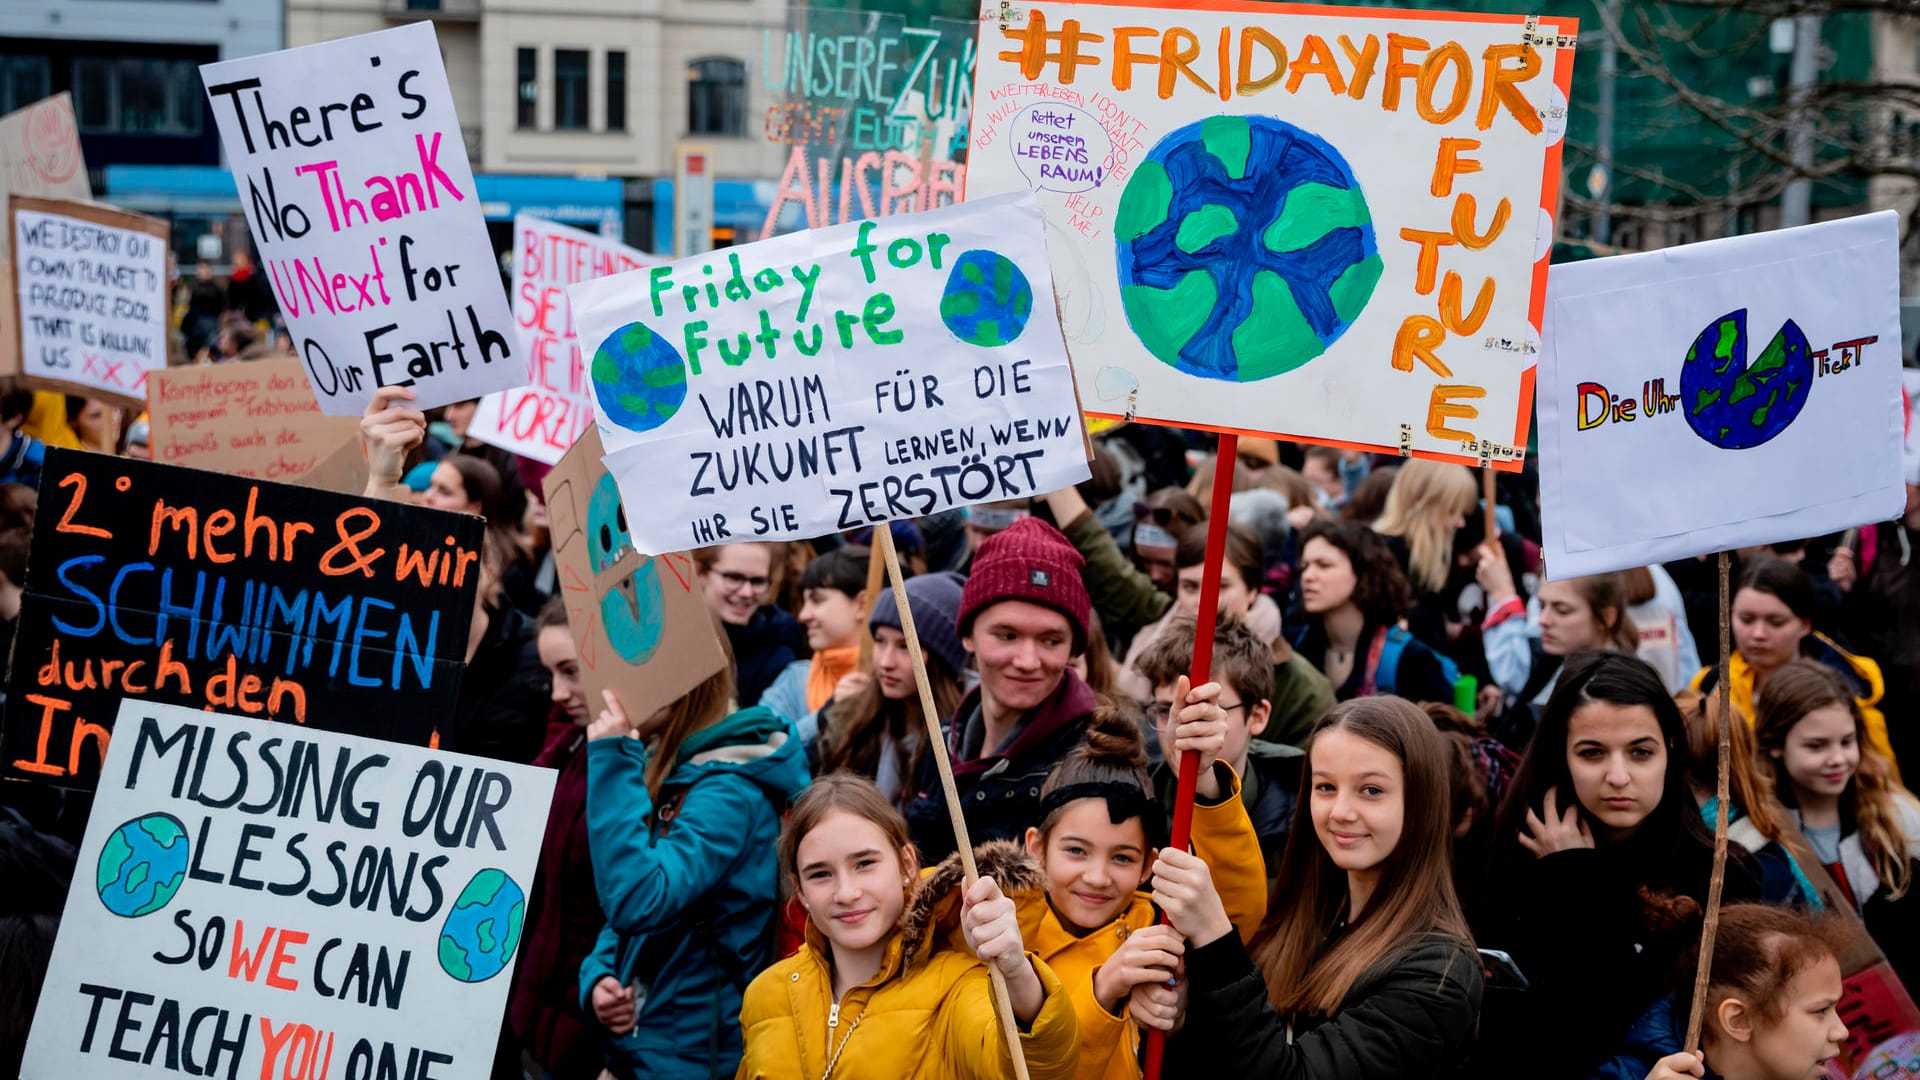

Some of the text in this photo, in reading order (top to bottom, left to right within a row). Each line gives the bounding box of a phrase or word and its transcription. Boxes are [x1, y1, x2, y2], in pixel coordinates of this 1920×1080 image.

[762, 29, 898, 103] UNSERE
[208, 56, 427, 154] There's
[765, 101, 846, 146] GEHT
[854, 108, 938, 153] EUCH
[976, 83, 1085, 150] ICH WILL WEITERLEBEN
[1028, 131, 1085, 148] unseren
[1032, 109, 1076, 130] Rettet
[1100, 116, 1144, 153] WANT
[1017, 142, 1088, 164] LEBENS
[1040, 163, 1103, 187] RAUM!
[20, 219, 57, 249] WE
[249, 167, 311, 244] No
[1064, 192, 1103, 219] HELP
[26, 256, 74, 280] OWN
[78, 259, 138, 291] PLANET
[399, 234, 460, 301] for
[523, 229, 589, 284] BITTE
[650, 252, 821, 323] Friday
[850, 221, 950, 284] for
[29, 315, 73, 339] THAT
[79, 323, 97, 346] IS
[40, 345, 71, 369] US
[304, 337, 364, 397] Our
[363, 304, 512, 388] Earth
[684, 292, 904, 375] Future
[699, 359, 1032, 439] WARUM FÜR DIE
[1577, 381, 1637, 431] Die
[1643, 378, 1680, 418] Uhr
[690, 425, 866, 497] ZUKUNFT
[990, 415, 1071, 446] WENN
[692, 512, 731, 545] IHR
[750, 504, 799, 535] SIE
[829, 449, 1045, 530] ZERSTÖRT
[148, 486, 315, 564] mehr
[318, 506, 385, 579] &
[395, 536, 479, 588] wir
[51, 554, 440, 691] SCHWIMMEN
[37, 637, 307, 723] durch den
[124, 717, 512, 851] MISSING OUR
[188, 816, 450, 923] LESSONS
[153, 909, 411, 1010] SO WE CAN
[79, 983, 252, 1080] TEACH
[259, 1017, 335, 1080] YOU
